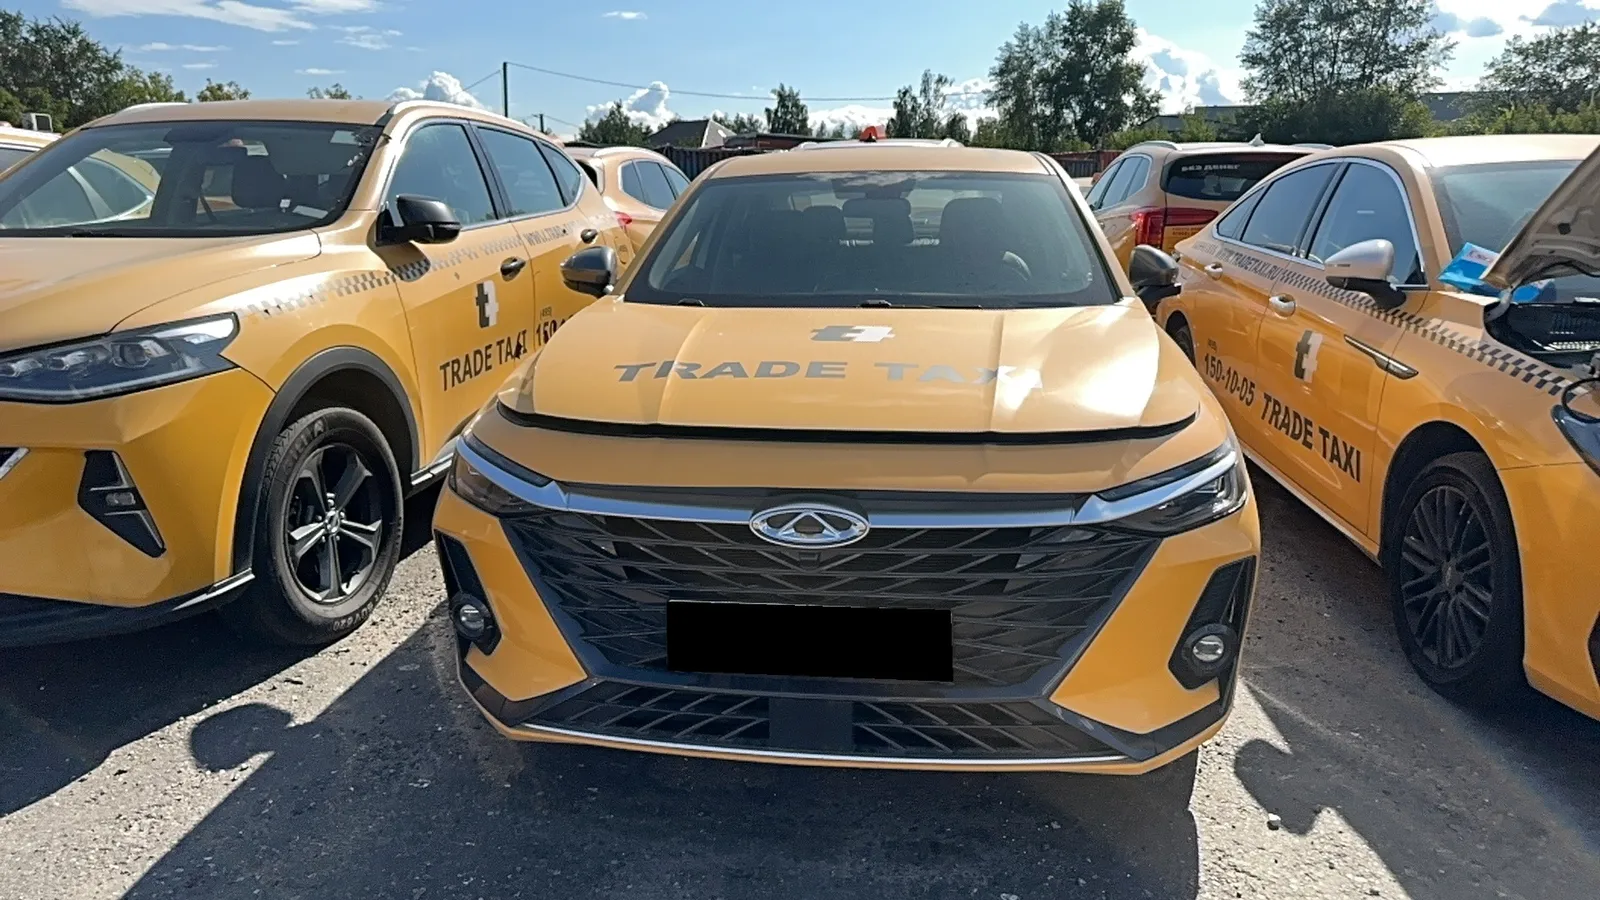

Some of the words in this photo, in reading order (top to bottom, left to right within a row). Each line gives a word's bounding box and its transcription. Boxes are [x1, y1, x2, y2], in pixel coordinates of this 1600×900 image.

[439, 343, 493, 391] TRADE
[613, 360, 848, 382] TRADE
[1204, 353, 1256, 407] 150-10-05
[1260, 392, 1314, 450] TRADE
[1318, 427, 1361, 483] TAXI
